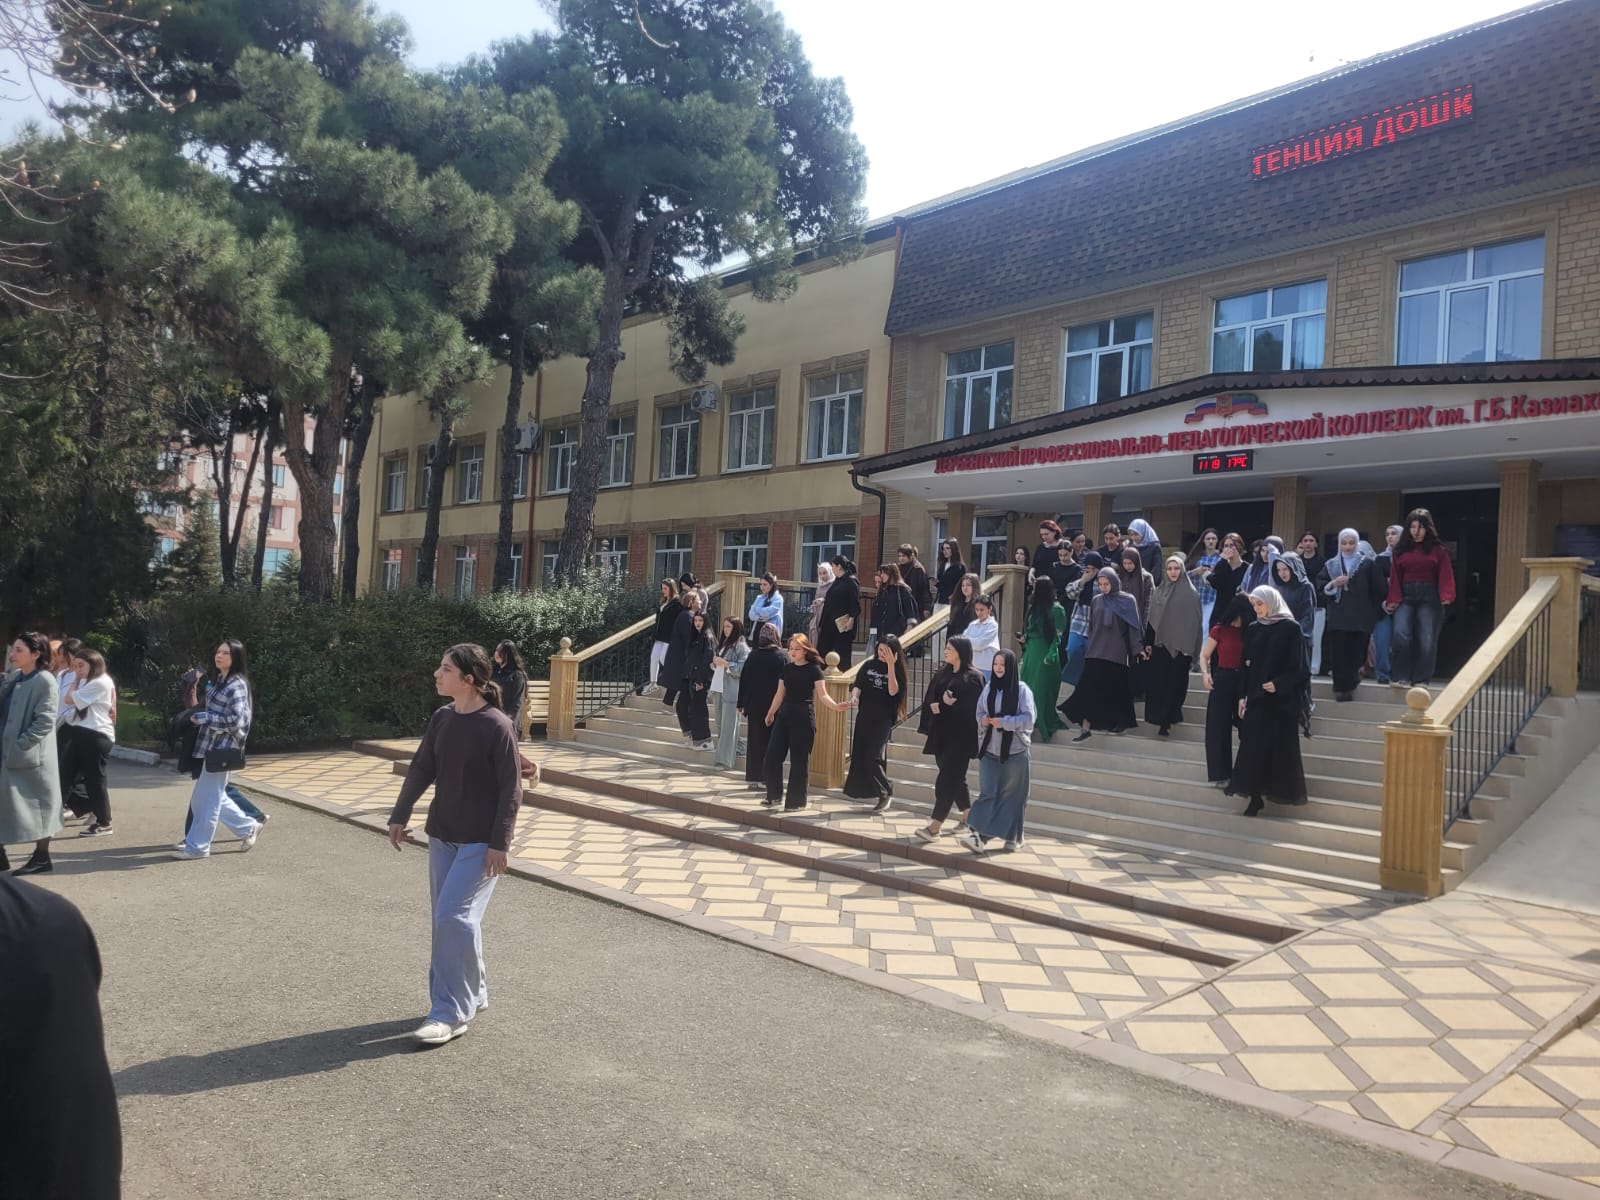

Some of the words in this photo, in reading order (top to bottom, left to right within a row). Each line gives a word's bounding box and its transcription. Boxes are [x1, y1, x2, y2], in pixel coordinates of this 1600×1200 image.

[1372, 92, 1473, 147] ДОШК
[1327, 405, 1434, 438] КОЛЛЕДЖ
[1435, 407, 1471, 426] им.
